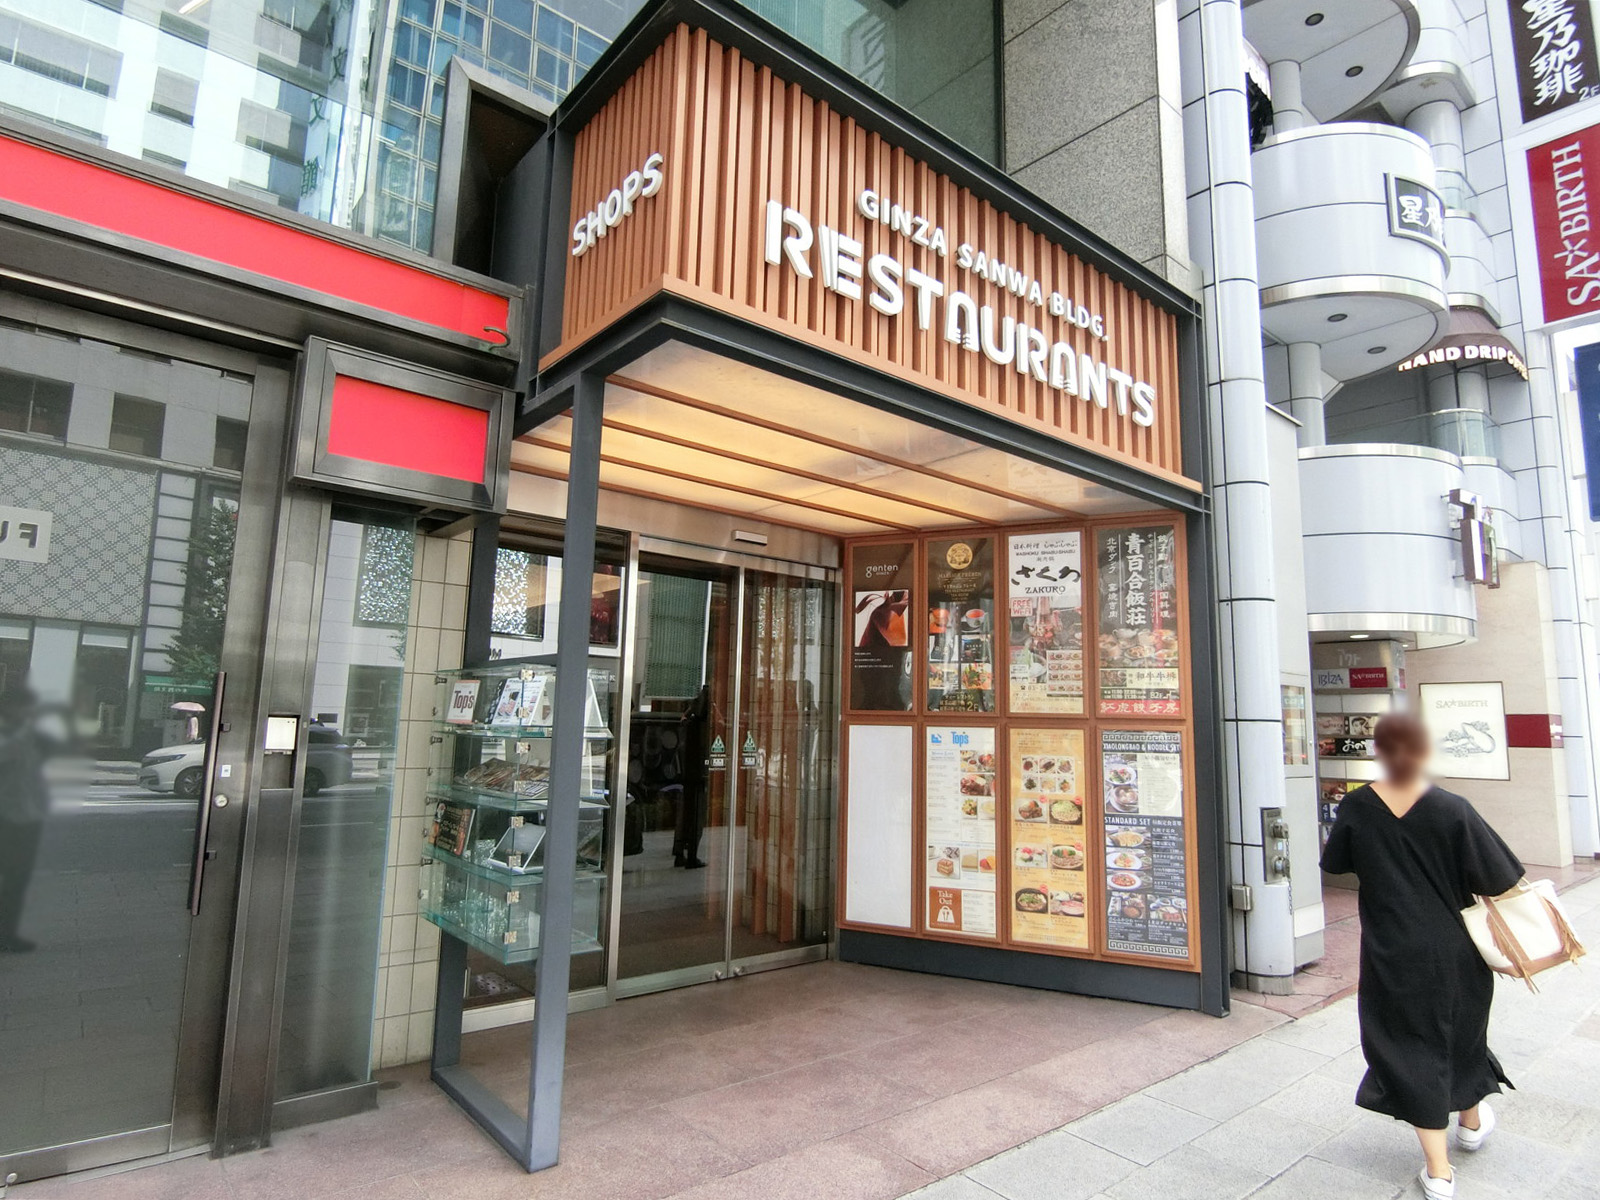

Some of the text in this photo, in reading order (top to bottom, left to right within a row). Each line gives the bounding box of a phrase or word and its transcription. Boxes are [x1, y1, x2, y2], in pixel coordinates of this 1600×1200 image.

[572, 153, 664, 257] SHOPS
[858, 190, 1109, 342] GINZA SANWA BLDG.
[765, 199, 1155, 427] RESTAURANTS
[1398, 346, 1460, 371] HAND
[1464, 345, 1506, 360] DRIP
[865, 563, 899, 578] genten
[1124, 532, 1148, 625] 青百合飯荘
[1025, 585, 1066, 594] ZAKURO
[453, 691, 475, 713] Top's
[951, 731, 969, 747] Top's
[1104, 817, 1137, 825] STANDARD
[1139, 818, 1150, 826] SET
[937, 890, 954, 898] Take
[939, 897, 953, 905] Out
